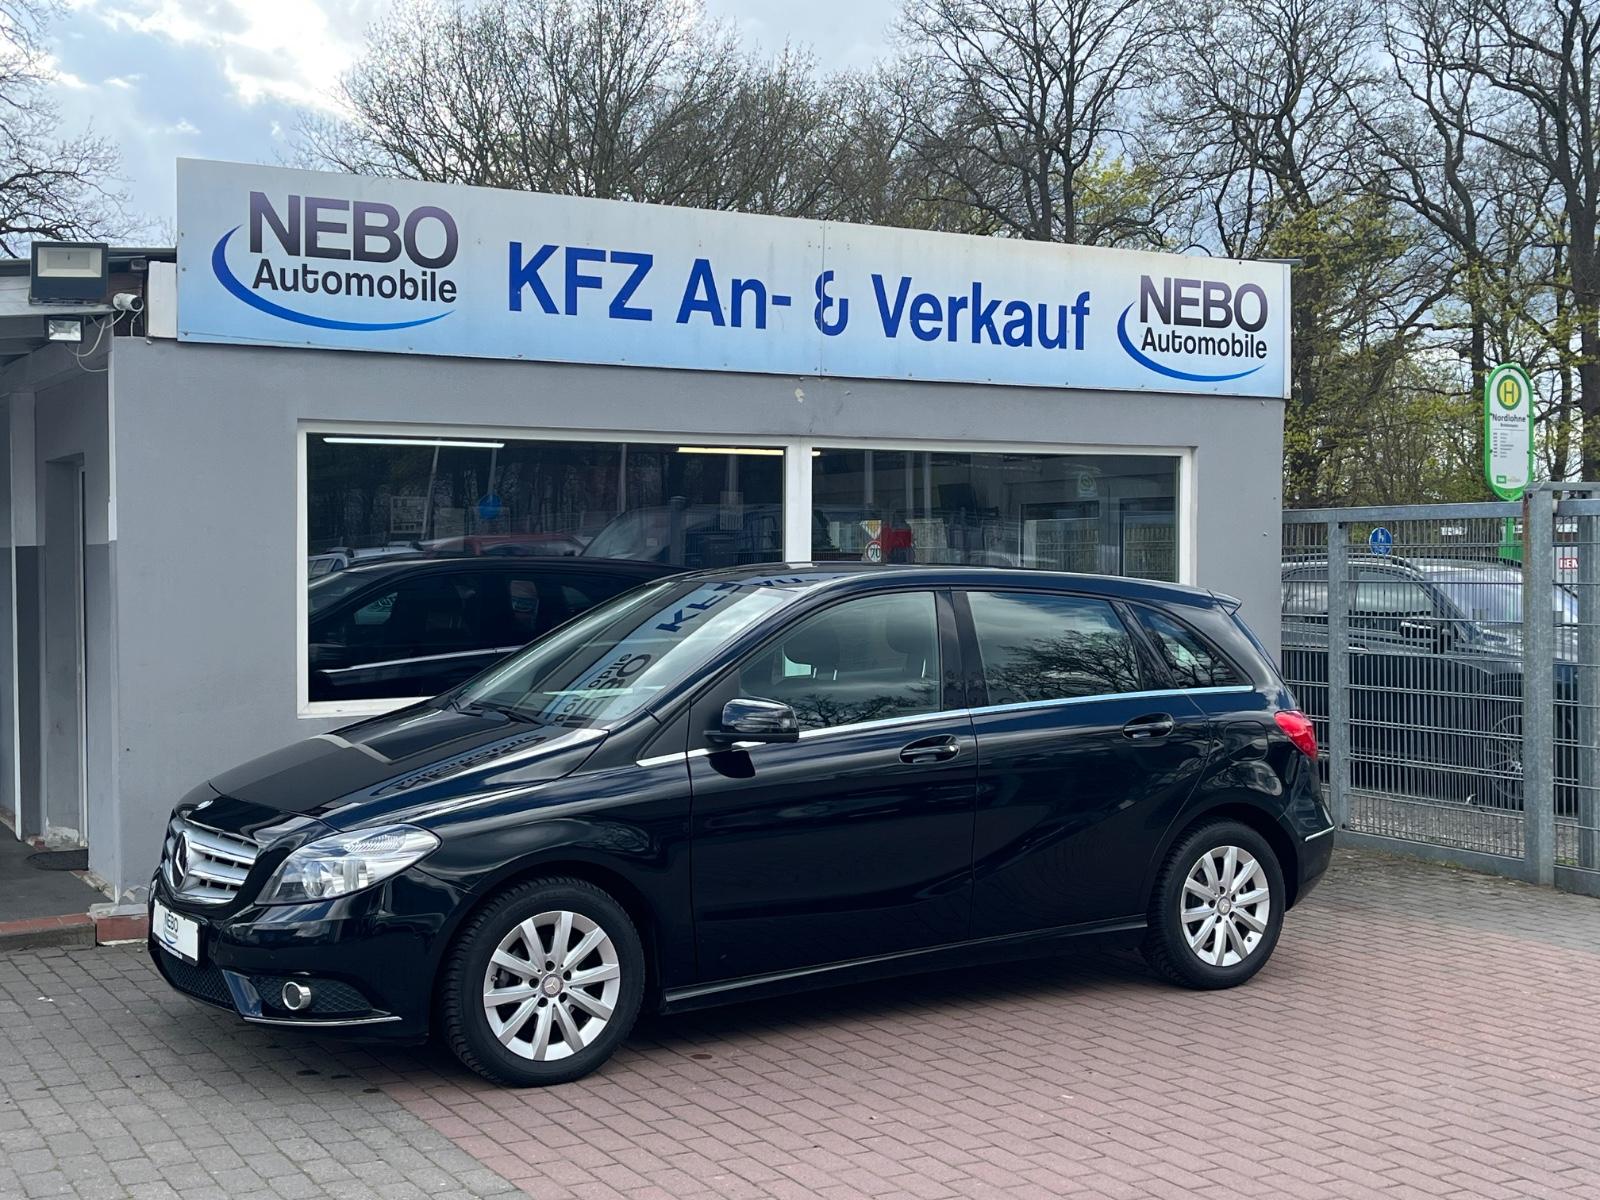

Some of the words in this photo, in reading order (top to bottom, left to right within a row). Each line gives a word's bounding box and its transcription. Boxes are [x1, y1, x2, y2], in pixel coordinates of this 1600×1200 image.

[249, 190, 459, 270] NEBO
[251, 258, 457, 304] Automobile
[508, 241, 654, 322] KFZ
[675, 258, 792, 330] An-
[814, 270, 849, 337] &
[870, 273, 1090, 351] Verkauf
[1139, 274, 1268, 333] NEBO
[1140, 326, 1268, 359] Automobile
[1503, 382, 1515, 403] H
